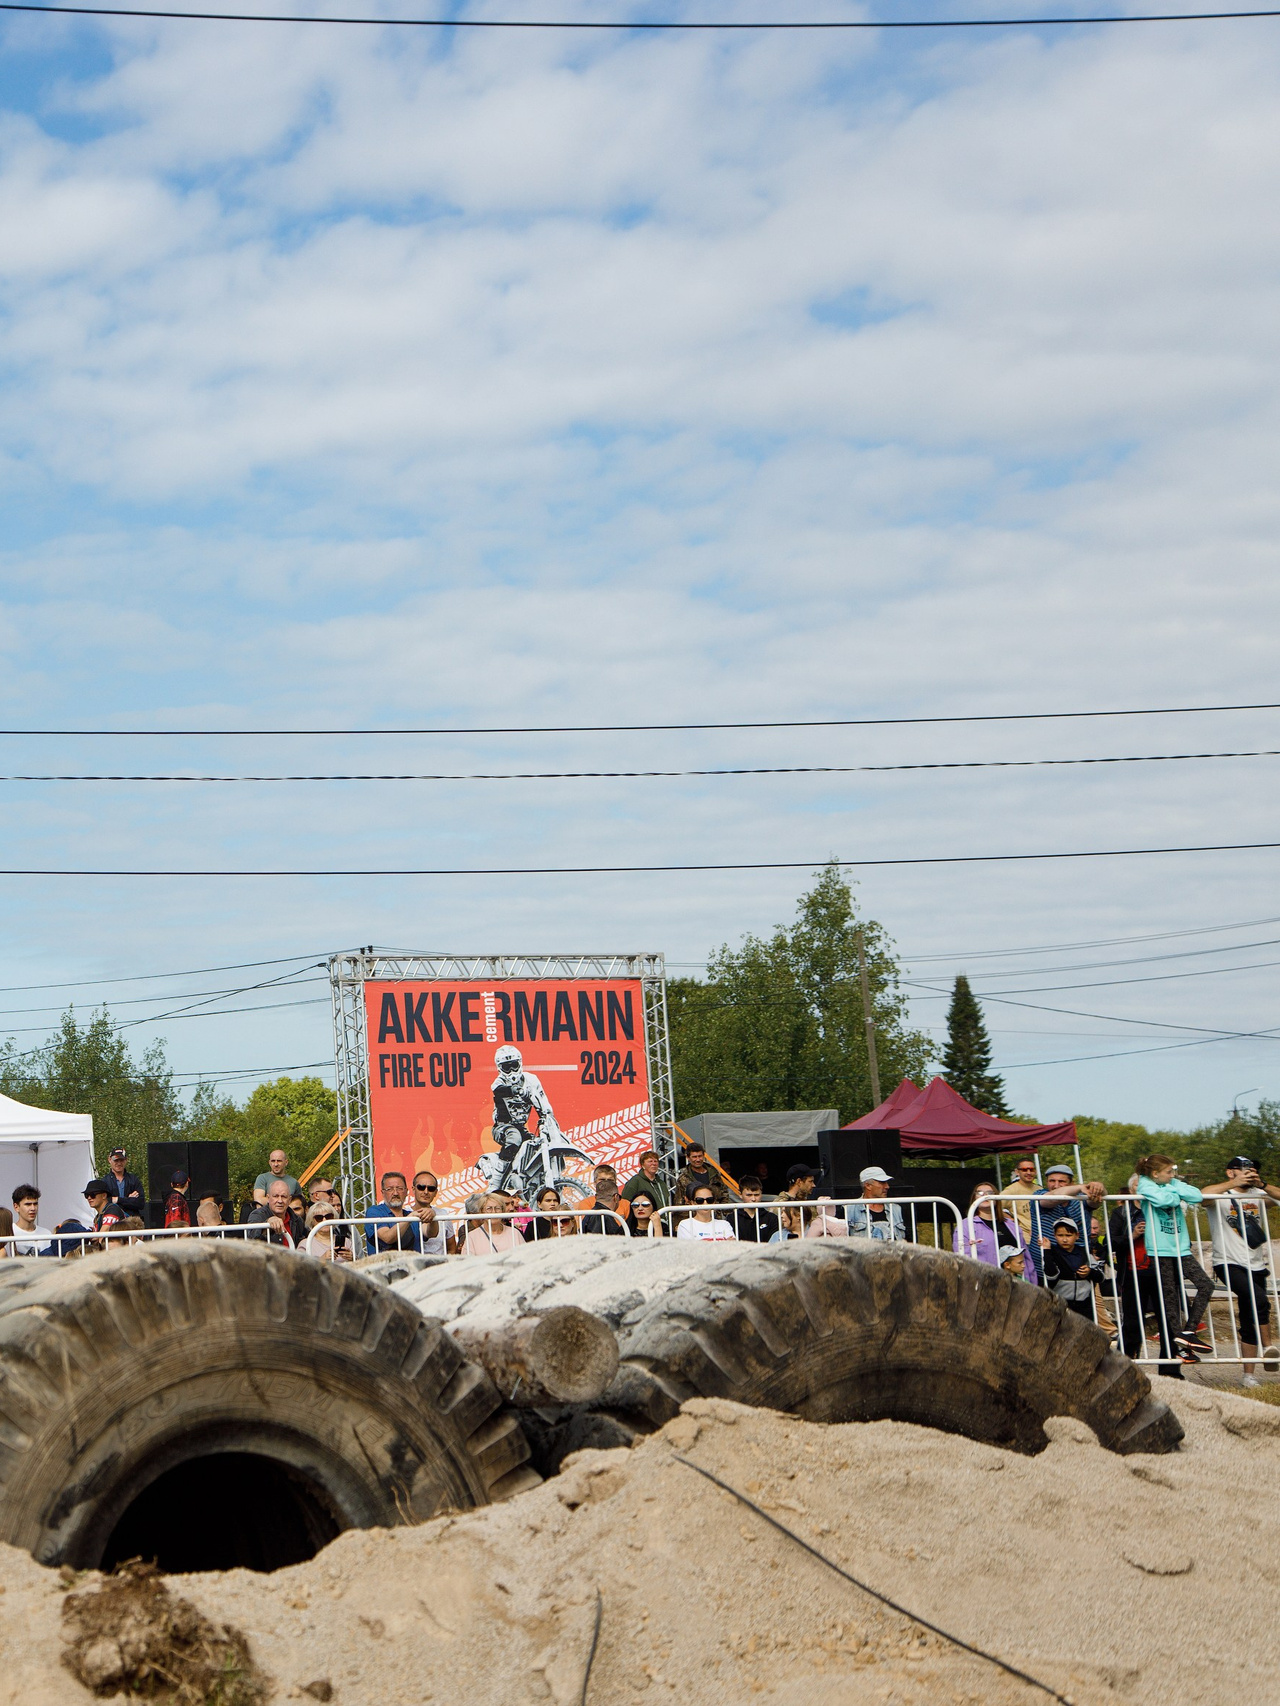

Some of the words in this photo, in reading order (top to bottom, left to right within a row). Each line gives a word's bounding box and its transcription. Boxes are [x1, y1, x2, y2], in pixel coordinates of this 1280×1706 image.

[480, 991, 498, 1044] cement
[379, 1053, 426, 1089] FIRE
[429, 1052, 472, 1088] CUP
[580, 1050, 637, 1086] 2024
